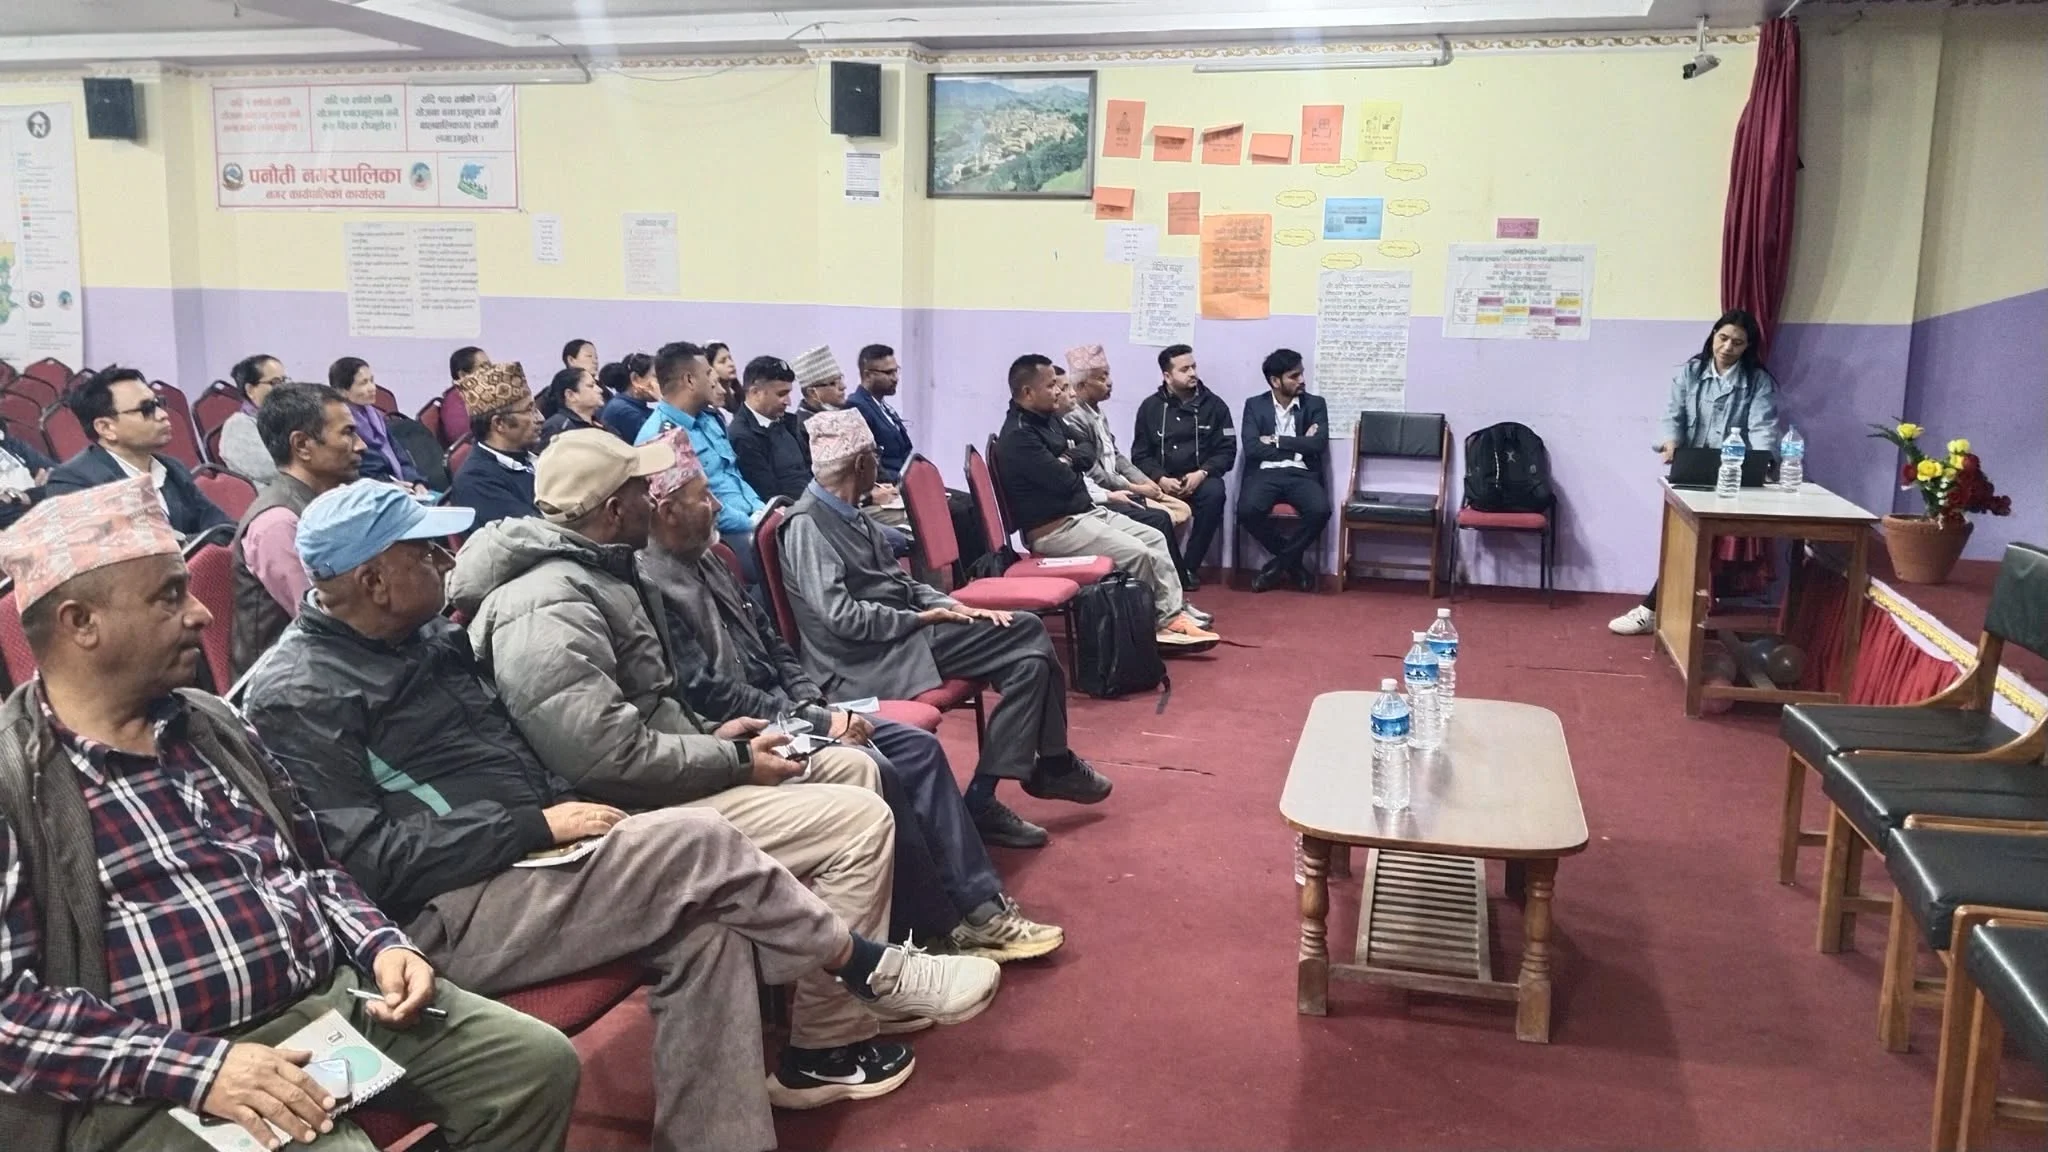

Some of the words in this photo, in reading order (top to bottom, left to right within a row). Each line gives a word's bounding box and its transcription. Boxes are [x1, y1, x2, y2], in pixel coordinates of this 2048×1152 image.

[248, 162, 296, 185] पनौती
[265, 188, 288, 200] नगर
[344, 186, 386, 200] कार्यालय
